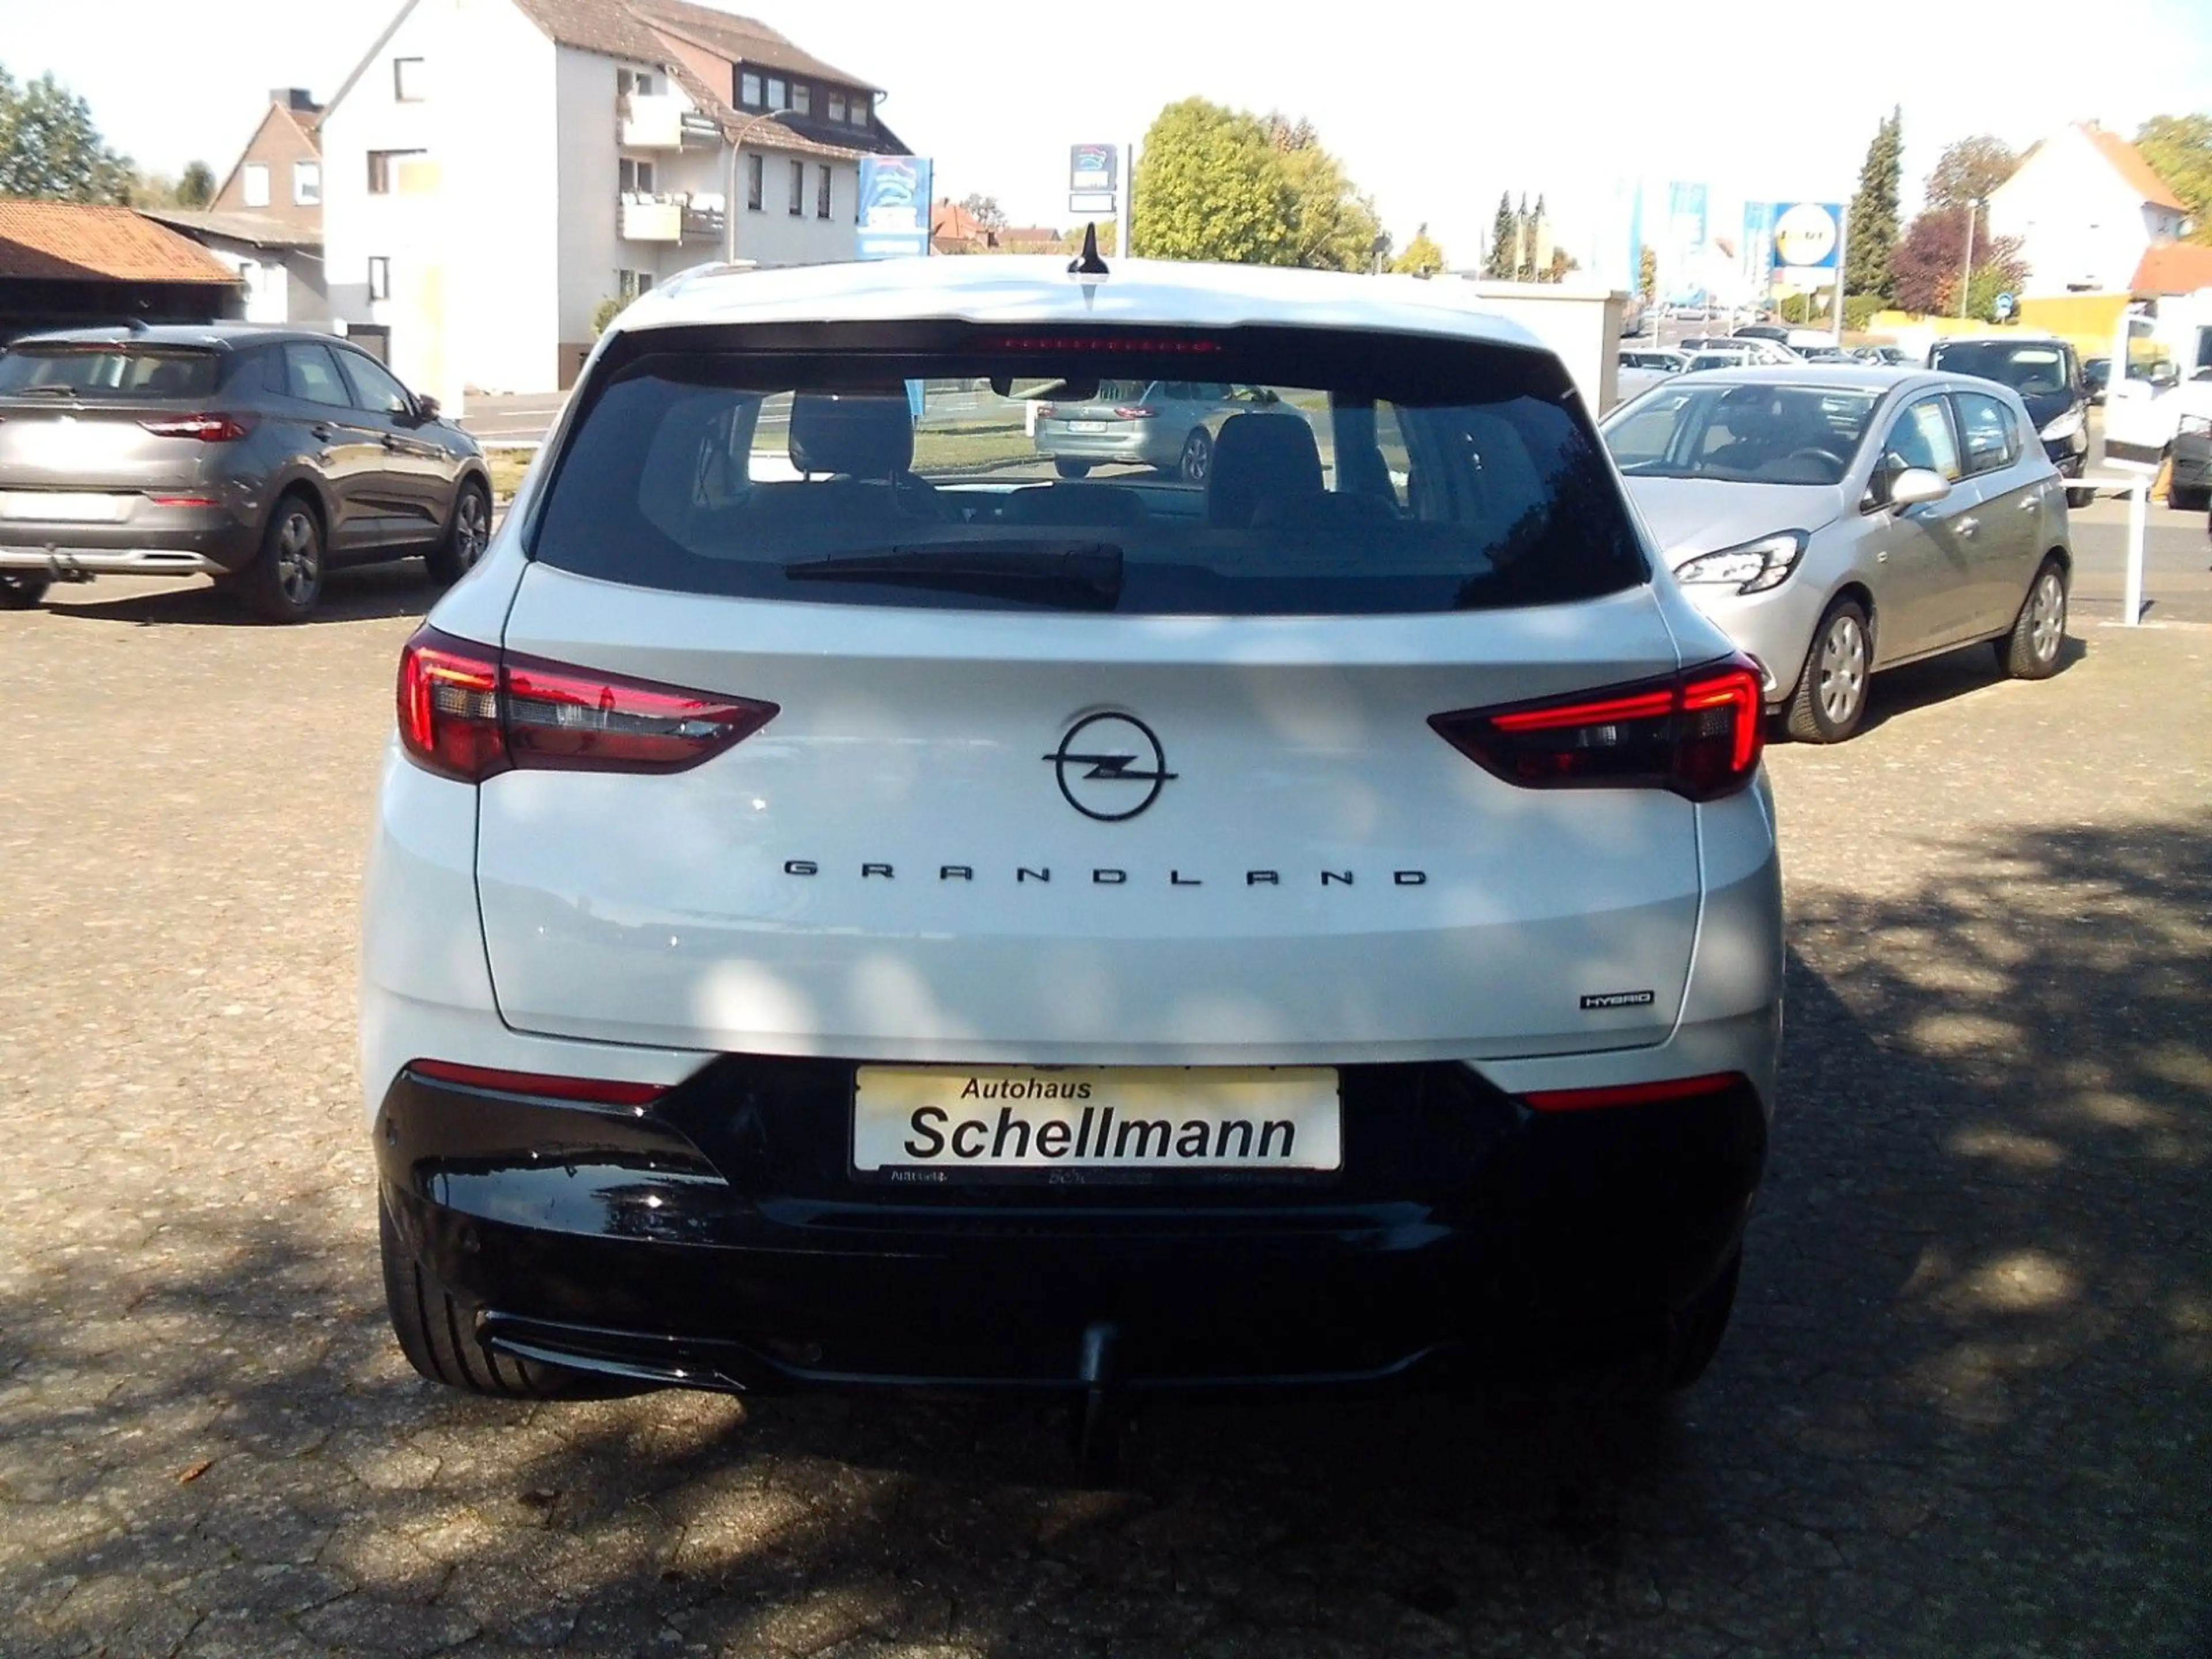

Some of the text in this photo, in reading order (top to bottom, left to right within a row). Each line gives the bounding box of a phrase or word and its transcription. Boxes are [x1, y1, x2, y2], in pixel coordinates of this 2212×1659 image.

[785, 861, 1427, 885] GRANDLAND
[1586, 993, 1650, 1006] HYBRID
[961, 1078, 1092, 1099] Autohaus
[904, 1106, 1296, 1158] Schellmann
